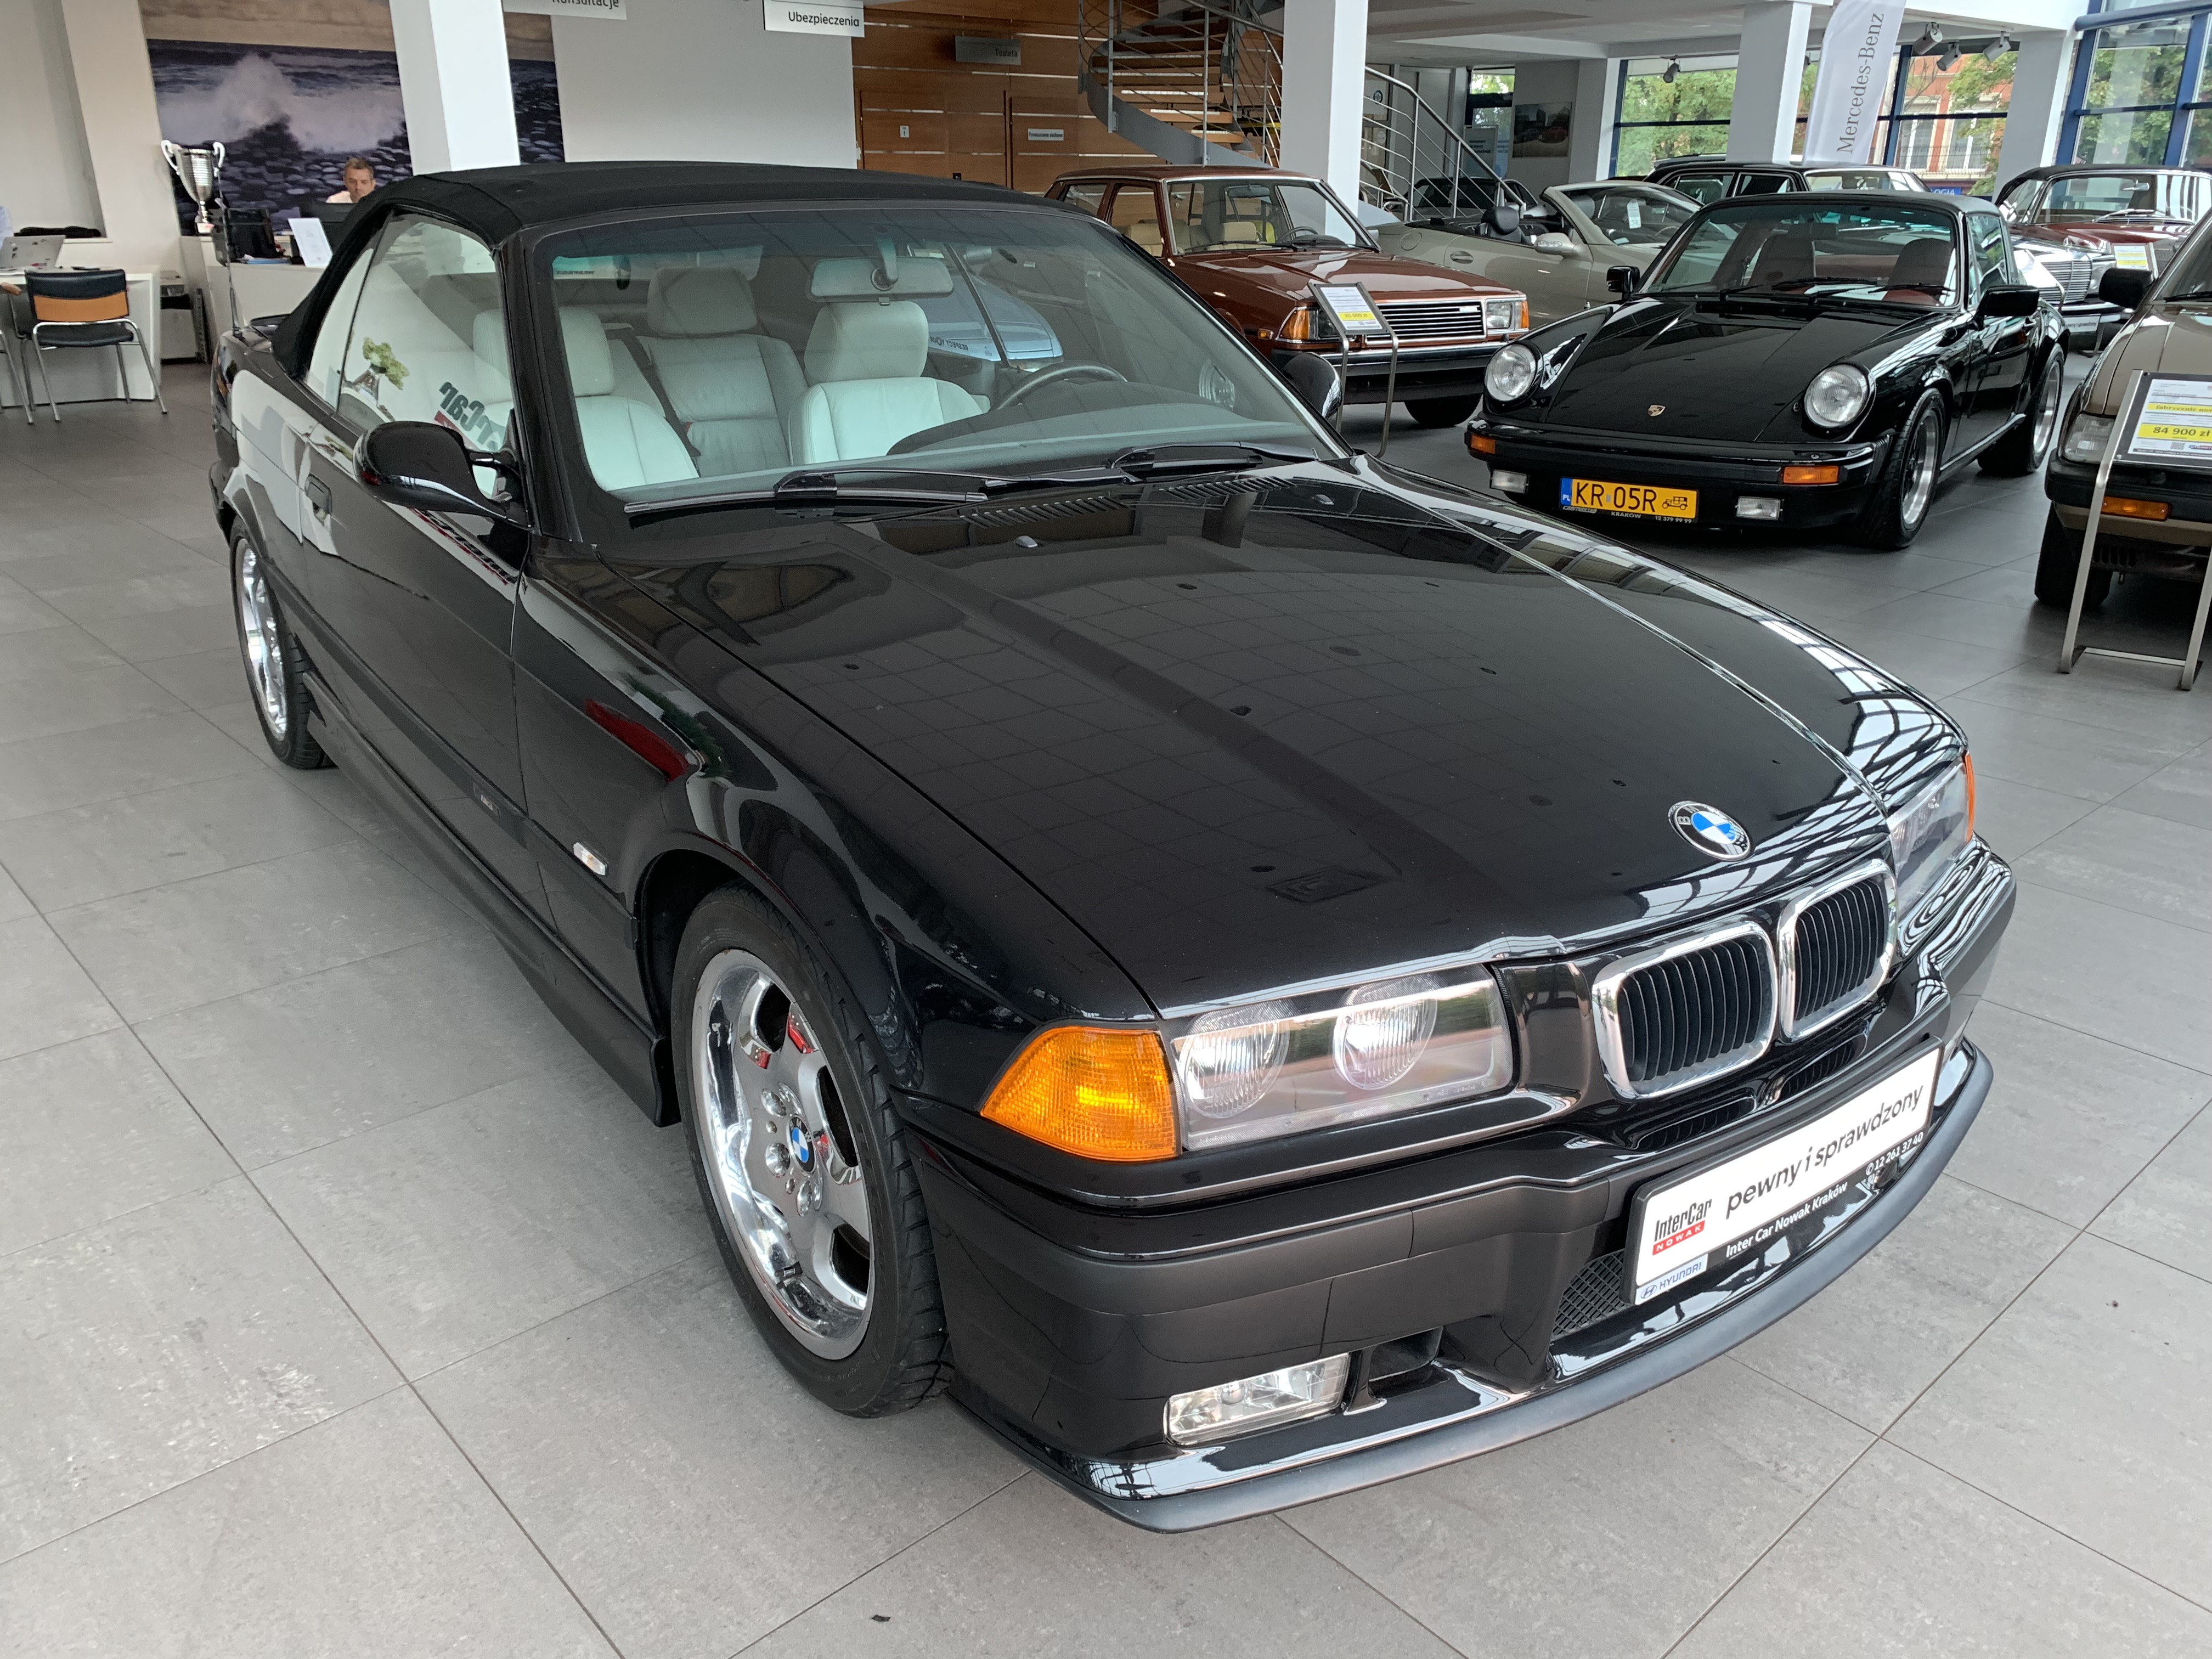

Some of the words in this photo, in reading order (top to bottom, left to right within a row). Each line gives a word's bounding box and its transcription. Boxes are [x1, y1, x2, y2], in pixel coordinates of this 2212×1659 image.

[552, 0, 619, 9] sutacje
[788, 11, 859, 26] Ubezpieczenia
[995, 48, 1018, 58] Toaleta
[1837, 13, 1884, 154] Mercedes-Benz
[2172, 428, 2197, 436] 900
[1576, 482, 1605, 507] KR
[1613, 486, 1657, 512] 05R
[1725, 1159, 1802, 1220] pewny
[1804, 1146, 1813, 1172] i
[1814, 1085, 1923, 1167] sprawdzony
[1875, 1156, 1885, 1171] 12
[1886, 1146, 1900, 1164] 261
[1901, 1138, 1912, 1153] 37
[1912, 1131, 1924, 1145] 40
[1654, 1199, 1713, 1243] InterCar
[1726, 1235, 1754, 1258] Inter
[1755, 1227, 1774, 1243] Car
[1774, 1203, 1810, 1232] Nowak
[1812, 1181, 1848, 1211] Kraków
[1656, 1224, 1702, 1252] NOWAK
[1659, 1261, 1702, 1290] HYUNDAI
